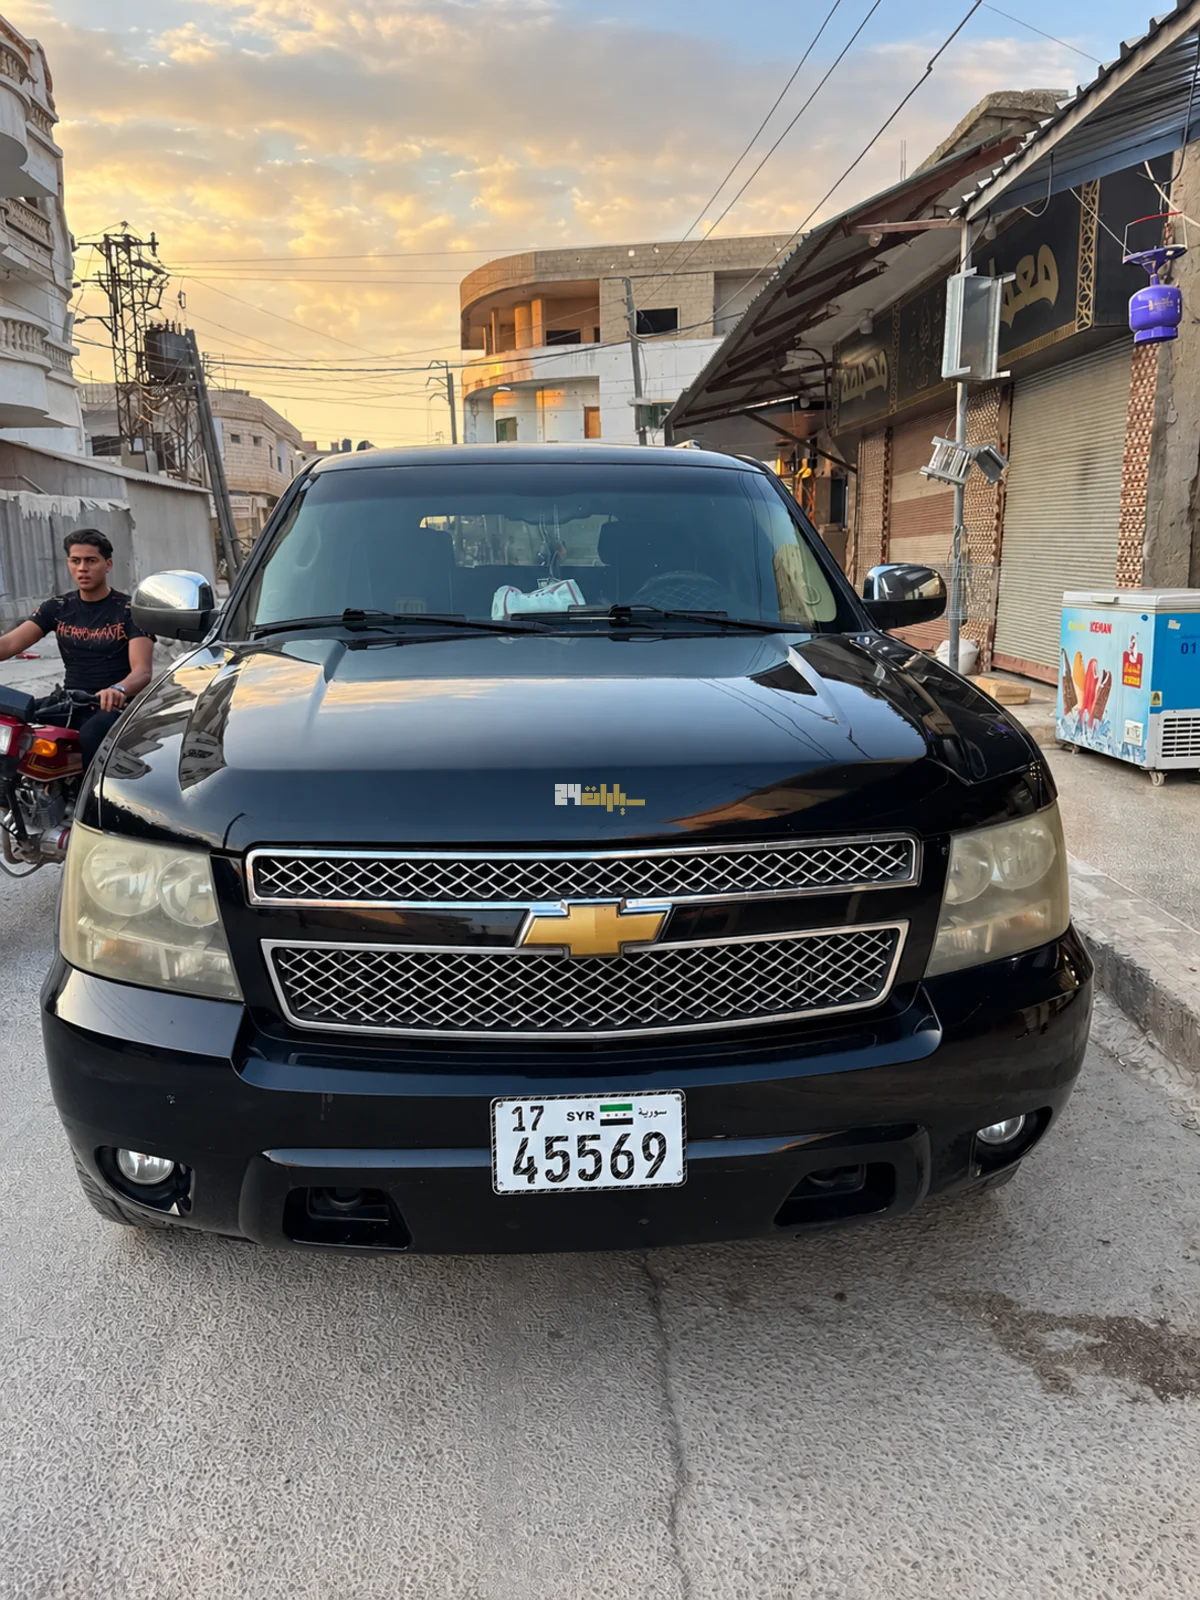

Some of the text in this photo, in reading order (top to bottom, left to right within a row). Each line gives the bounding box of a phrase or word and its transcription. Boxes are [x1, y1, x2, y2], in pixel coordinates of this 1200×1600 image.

[988, 244, 1059, 329] معم
[511, 1105, 545, 1132] 17
[566, 1111, 595, 1122] SYR
[637, 1107, 667, 1118] سورية
[512, 1131, 667, 1185] 45569
